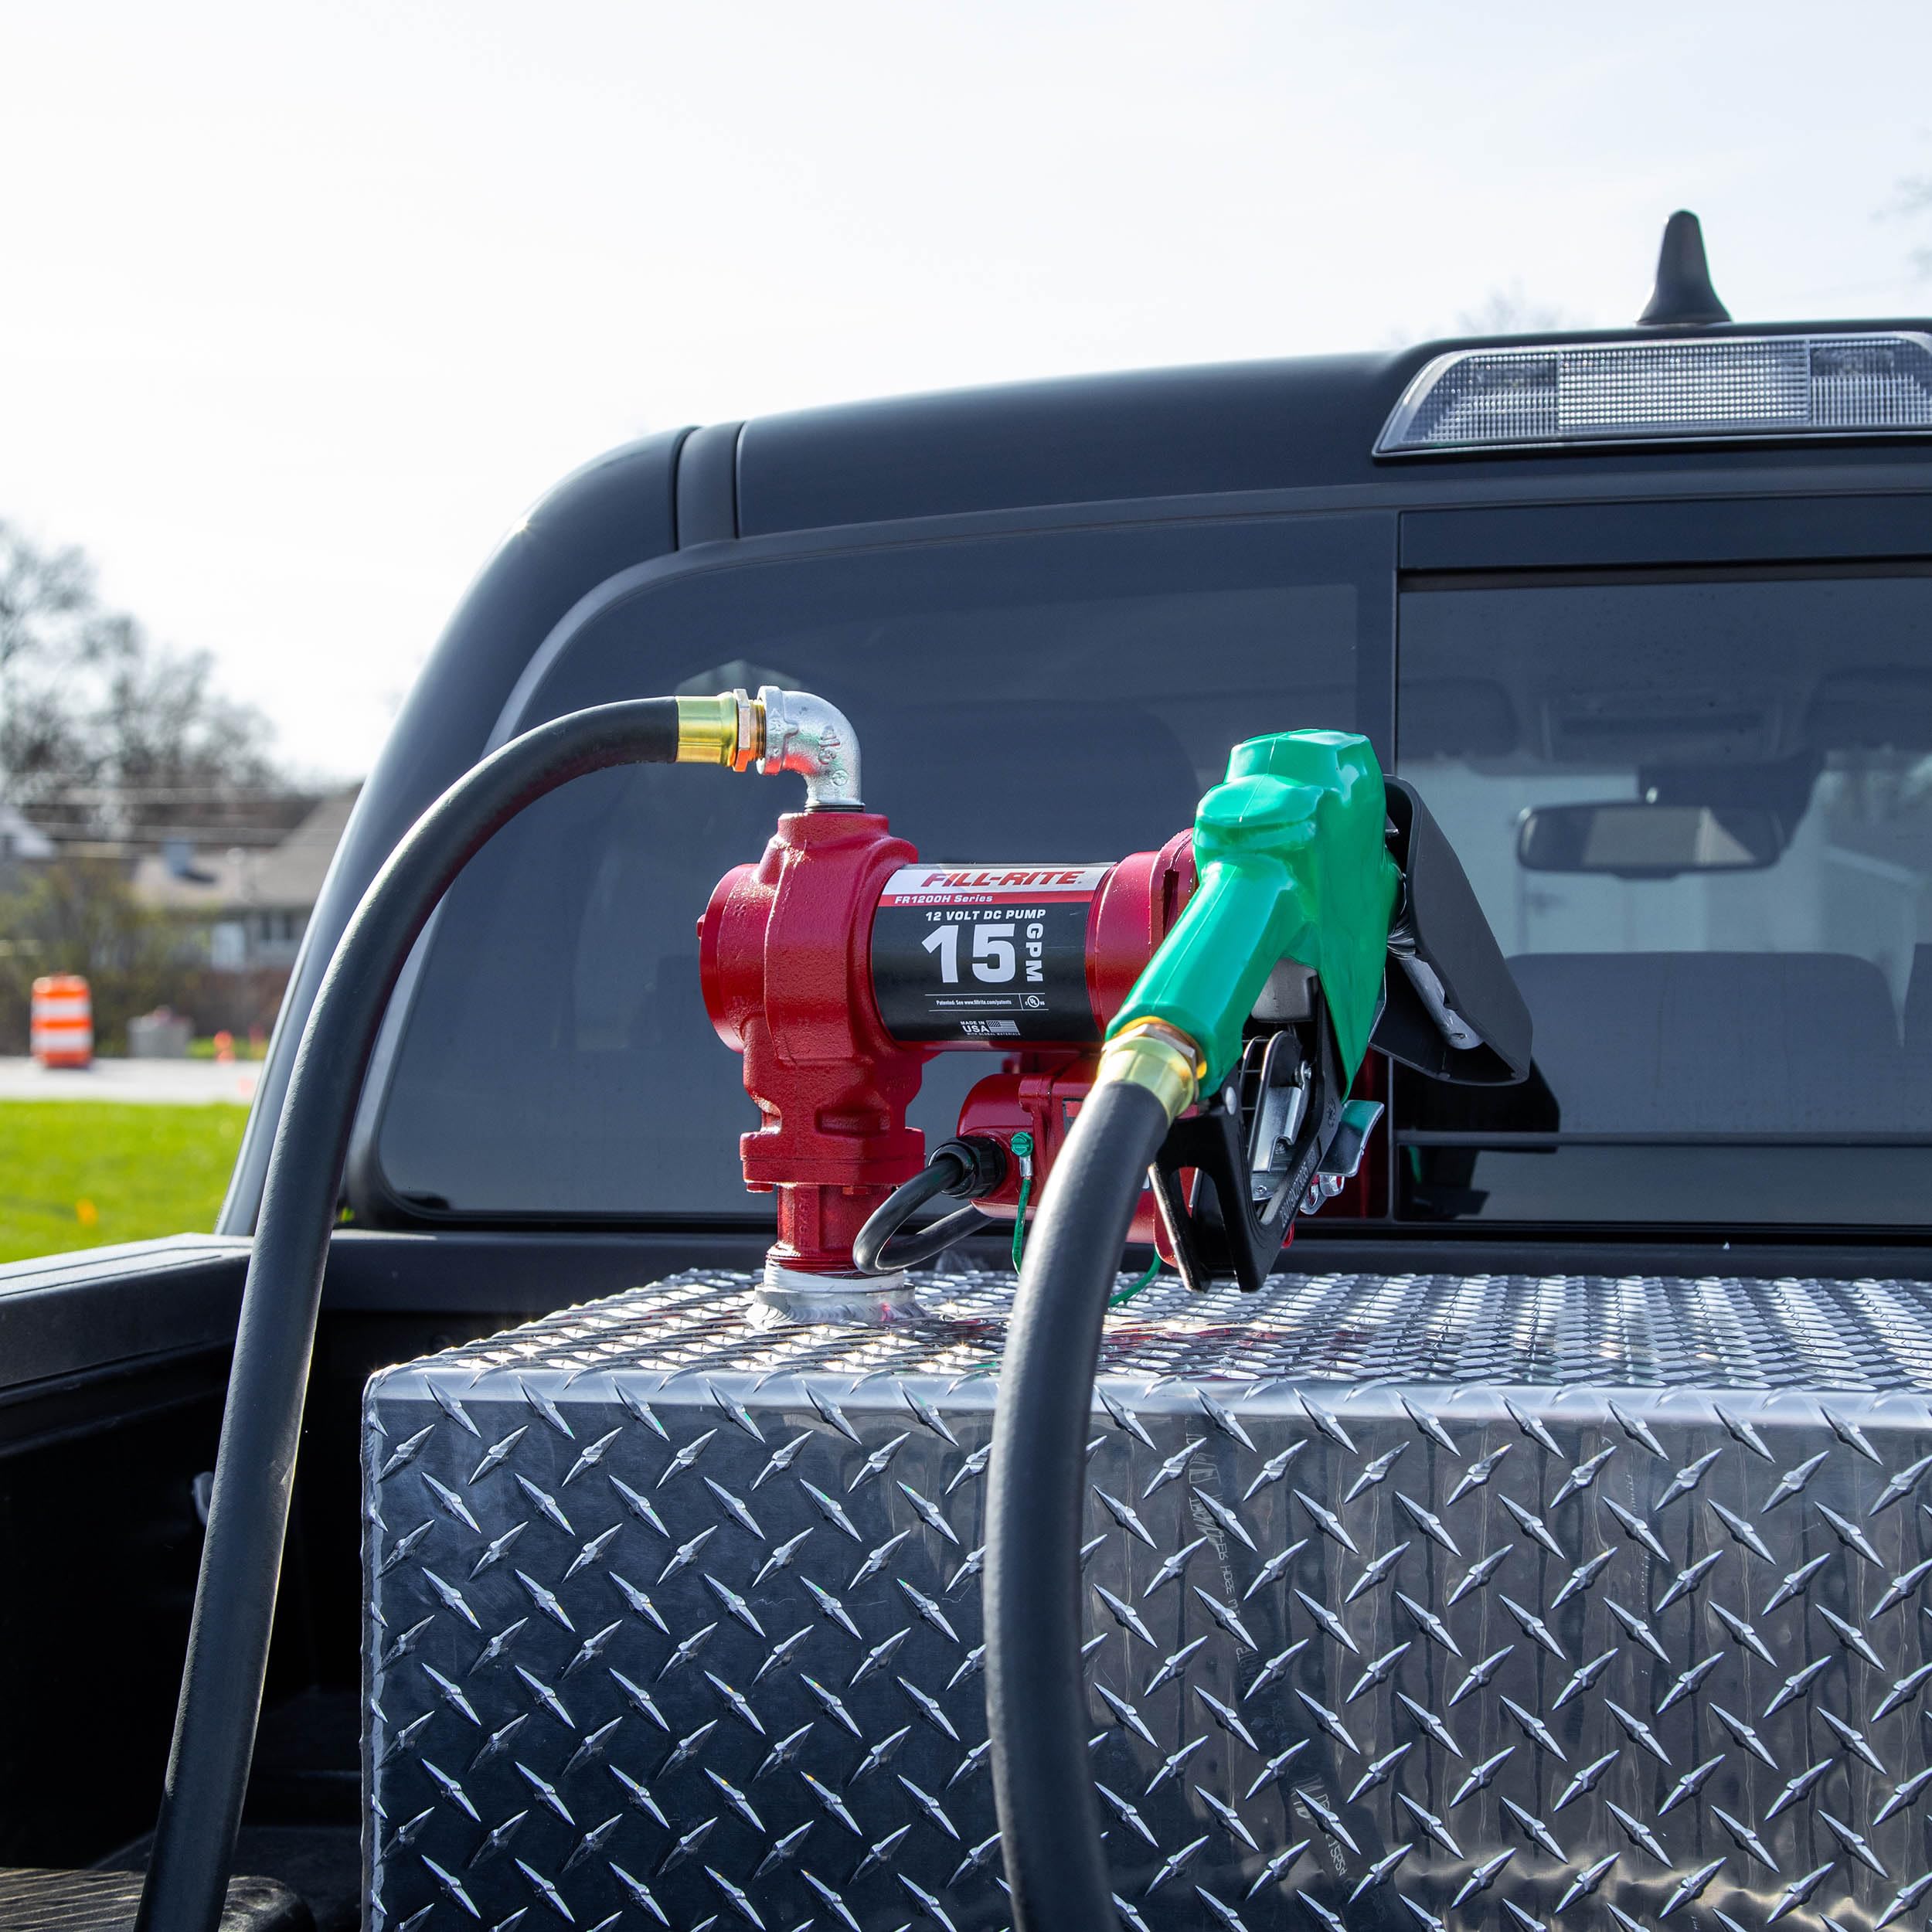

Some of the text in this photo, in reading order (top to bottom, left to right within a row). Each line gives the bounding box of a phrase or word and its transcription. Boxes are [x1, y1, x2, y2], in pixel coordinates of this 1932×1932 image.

[920, 870, 1085, 887] FILL-RITE
[894, 894, 994, 904] FR1200H Series
[925, 909, 1046, 921] 12 VOLT DC PUMP
[921, 923, 1016, 983] 15
[1026, 923, 1044, 982] GPM
